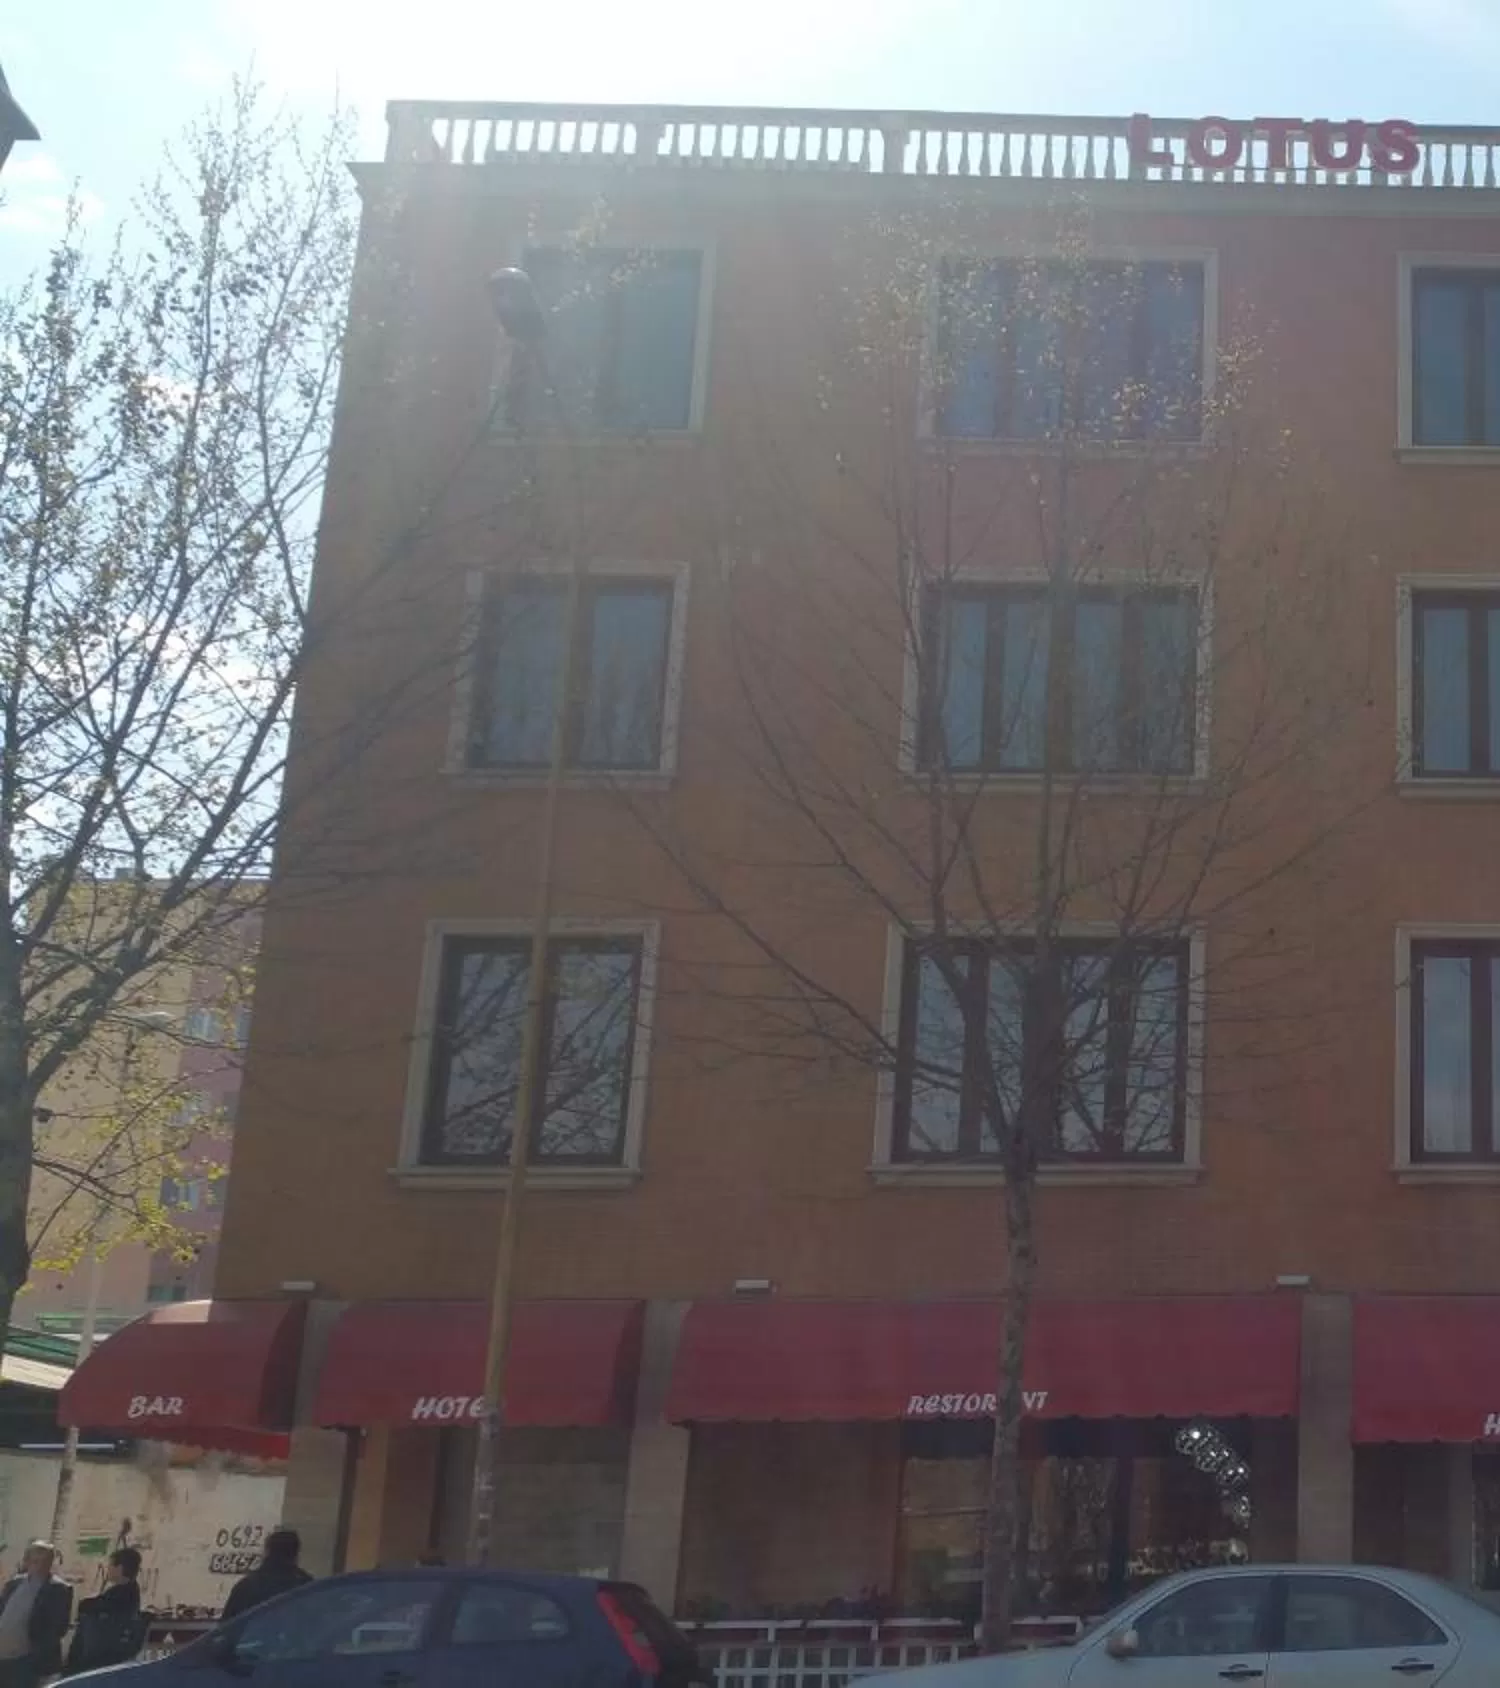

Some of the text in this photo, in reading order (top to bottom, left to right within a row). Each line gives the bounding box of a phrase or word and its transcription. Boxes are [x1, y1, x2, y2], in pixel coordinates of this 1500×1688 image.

[1128, 112, 1421, 173] LOTUS
[127, 1395, 183, 1418] BAR
[410, 1395, 487, 1420] HOTE
[906, 1391, 1049, 1414] RESTORNT
